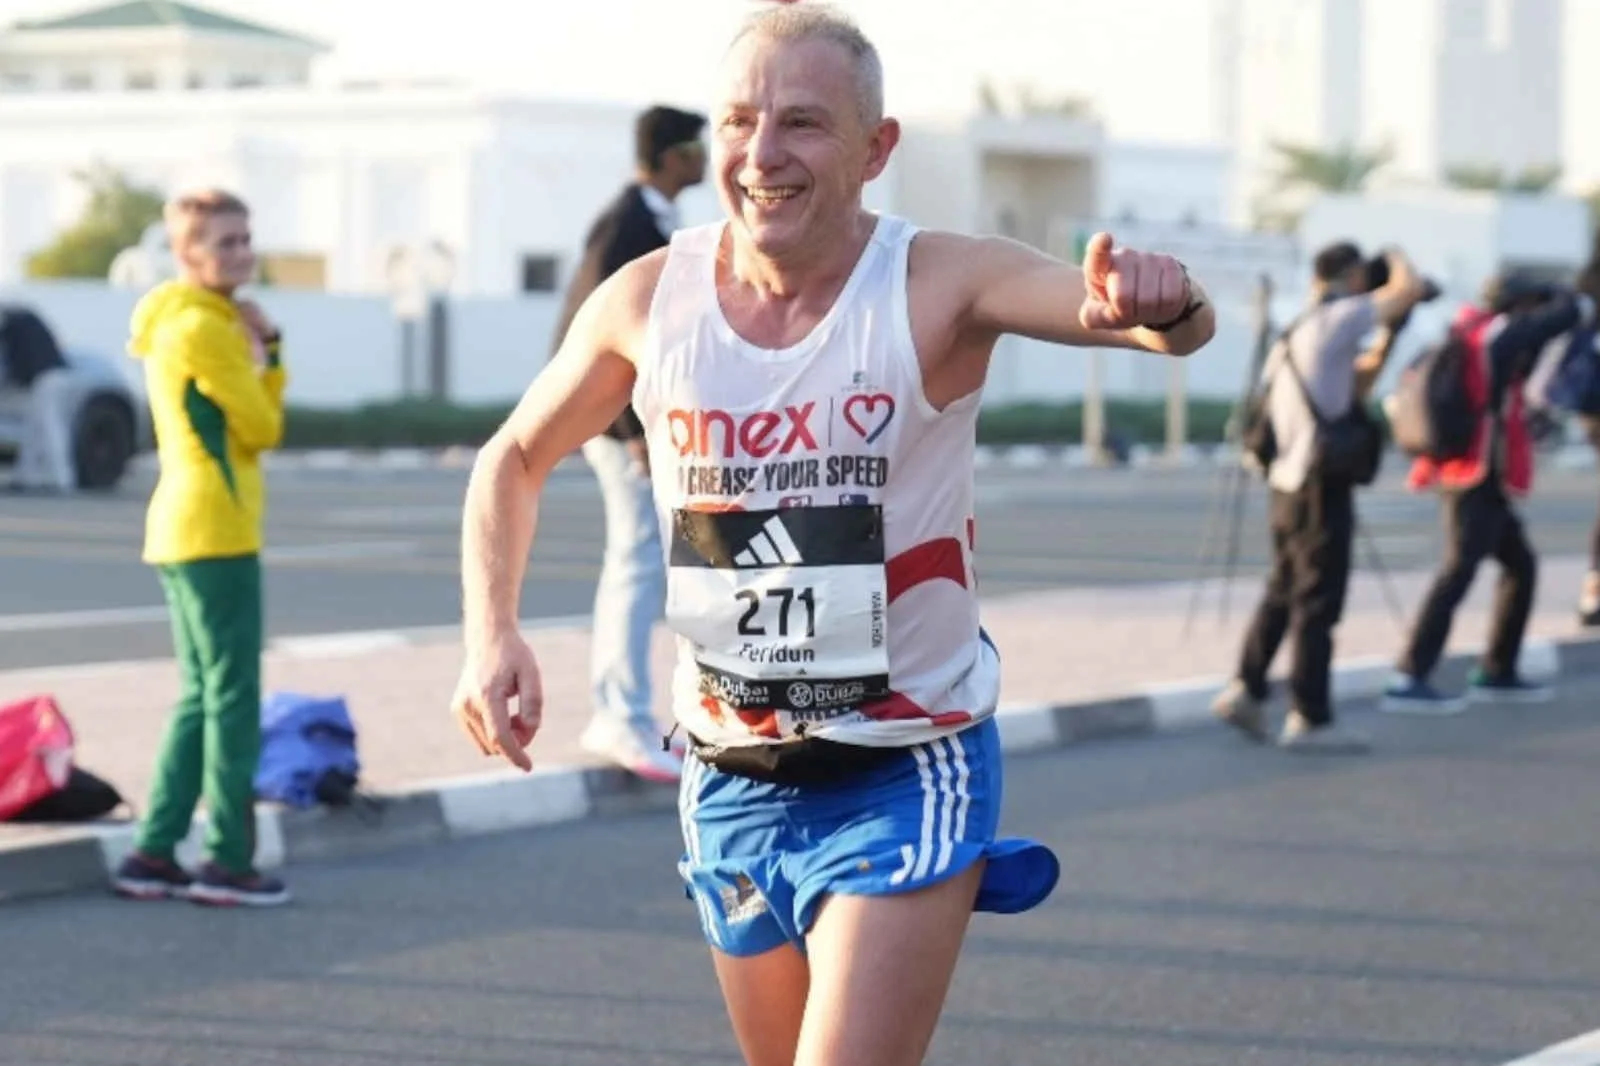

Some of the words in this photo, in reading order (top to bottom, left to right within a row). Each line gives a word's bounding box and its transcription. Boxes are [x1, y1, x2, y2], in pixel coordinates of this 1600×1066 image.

[667, 401, 819, 458] anex
[764, 459, 819, 491] YOUR
[826, 456, 888, 488] SPEED
[735, 587, 815, 637] 271
[872, 591, 884, 648] MARATHON
[739, 643, 815, 663] Feridun
